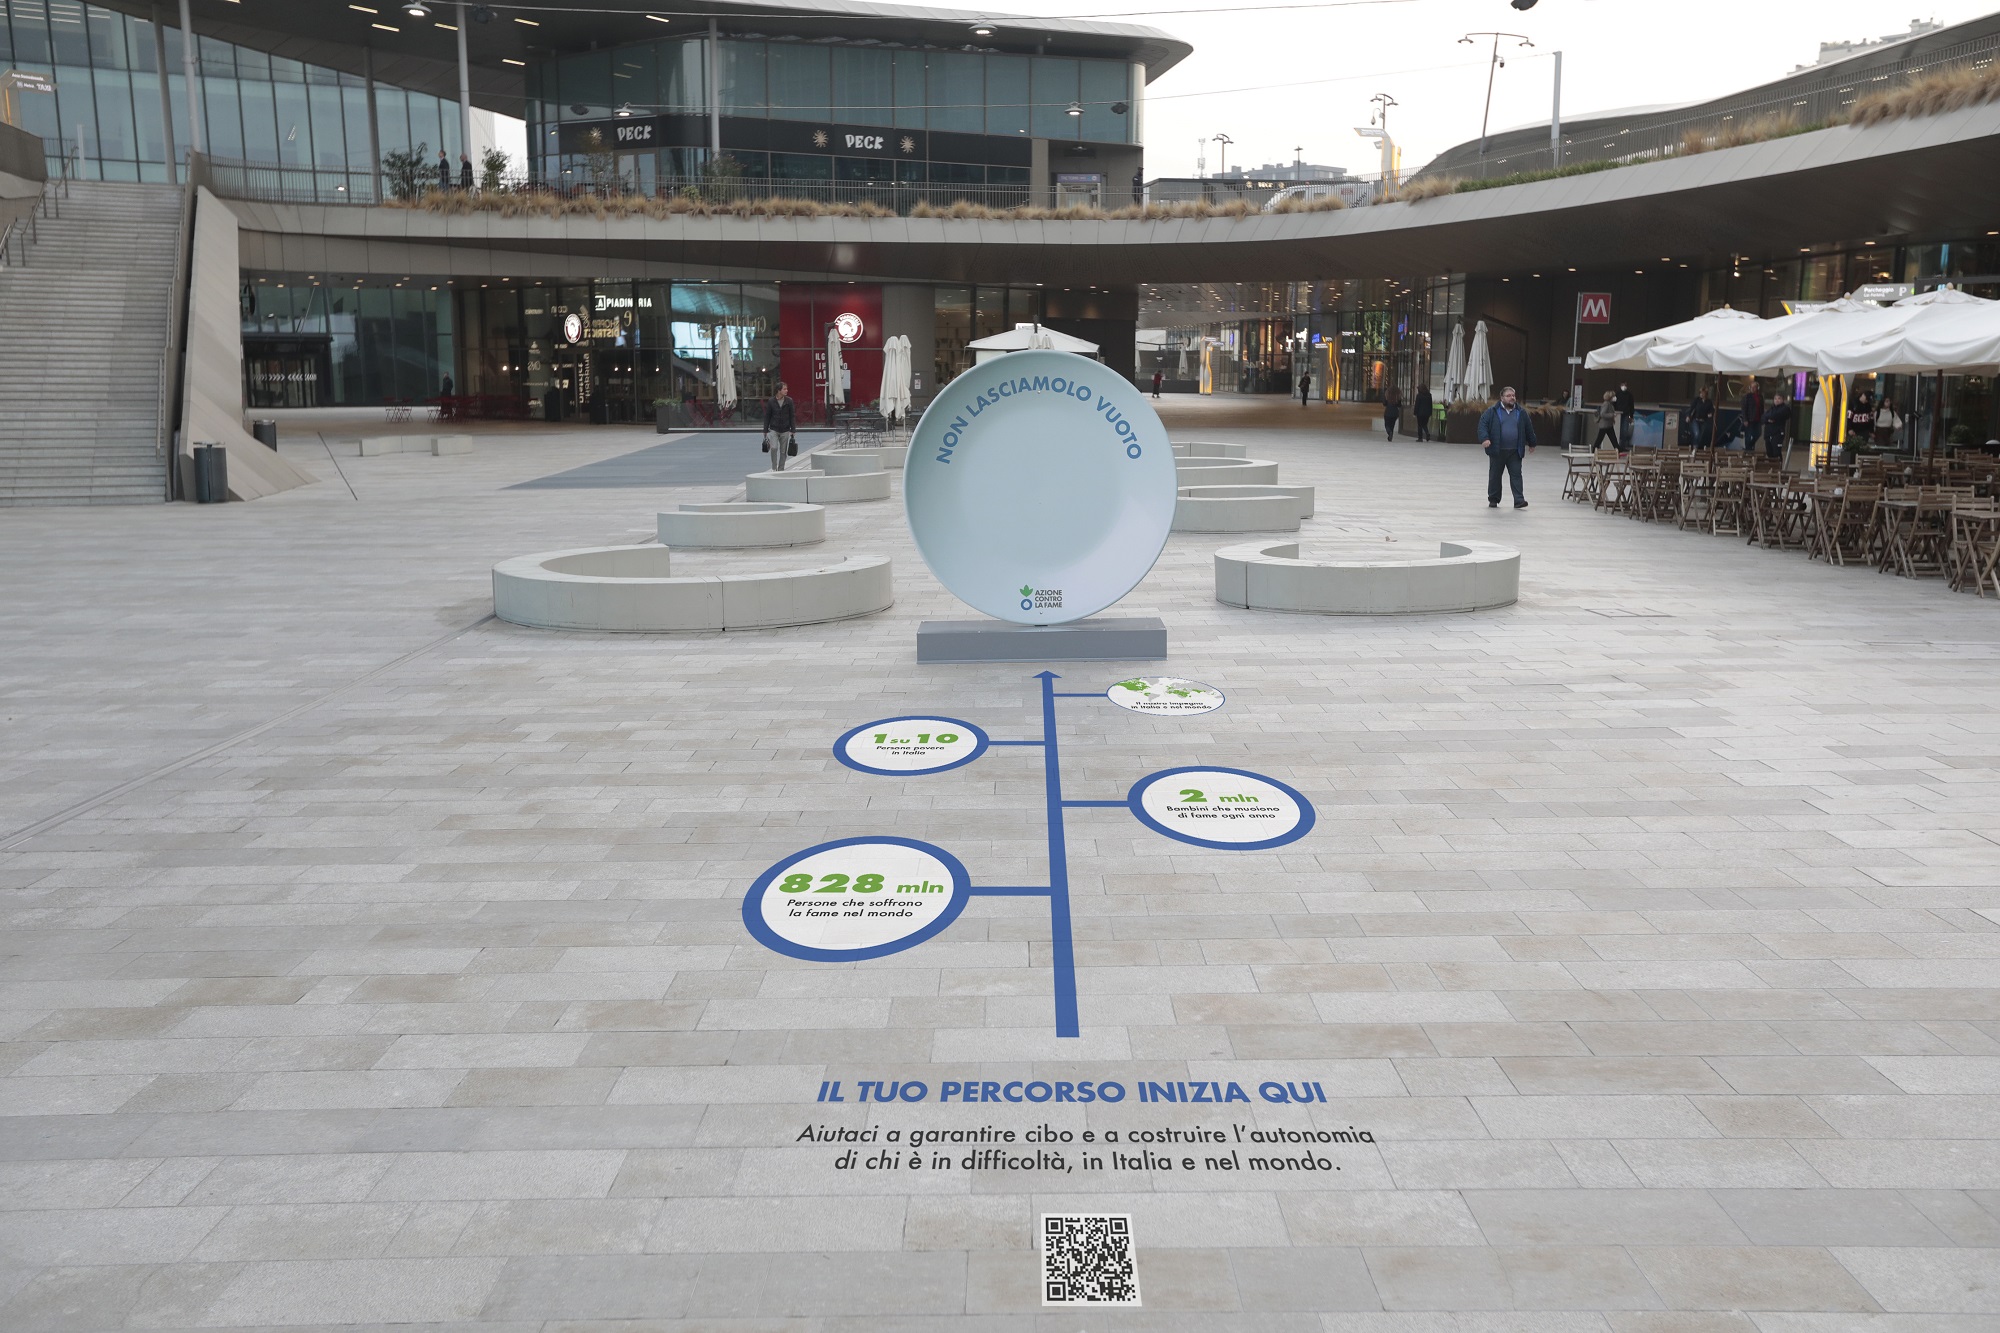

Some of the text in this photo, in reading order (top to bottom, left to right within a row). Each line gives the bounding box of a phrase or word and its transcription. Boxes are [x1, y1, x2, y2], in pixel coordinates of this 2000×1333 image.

[617, 125, 652, 141] PECK
[845, 134, 884, 150] PECK
[606, 298, 652, 308] PIADINRIA
[1583, 299, 1607, 317] M
[936, 376, 1141, 464] NON LASCIAMOLO VUOTO
[874, 734, 888, 744] 1
[917, 734, 958, 744] 10
[1179, 789, 1259, 802] 2 mln
[778, 874, 944, 894] 828 mln
[786, 899, 923, 907] Persone che soffrono
[788, 908, 913, 917] la fame nel mondo
[817, 1081, 1328, 1104] IL TUO PERCORSO INIZIA QUI
[796, 1124, 879, 1142] Aiutaci
[886, 1130, 901, 1142] a
[909, 1125, 1016, 1147] garantire
[1025, 1124, 1074, 1142] cibo
[1082, 1130, 1095, 1142] e
[1104, 1130, 1119, 1142] a
[1128, 1125, 1227, 1142] costruire
[834, 1149, 1341, 1173] di chi è in difficoltà, in Italia e nel mondo.
